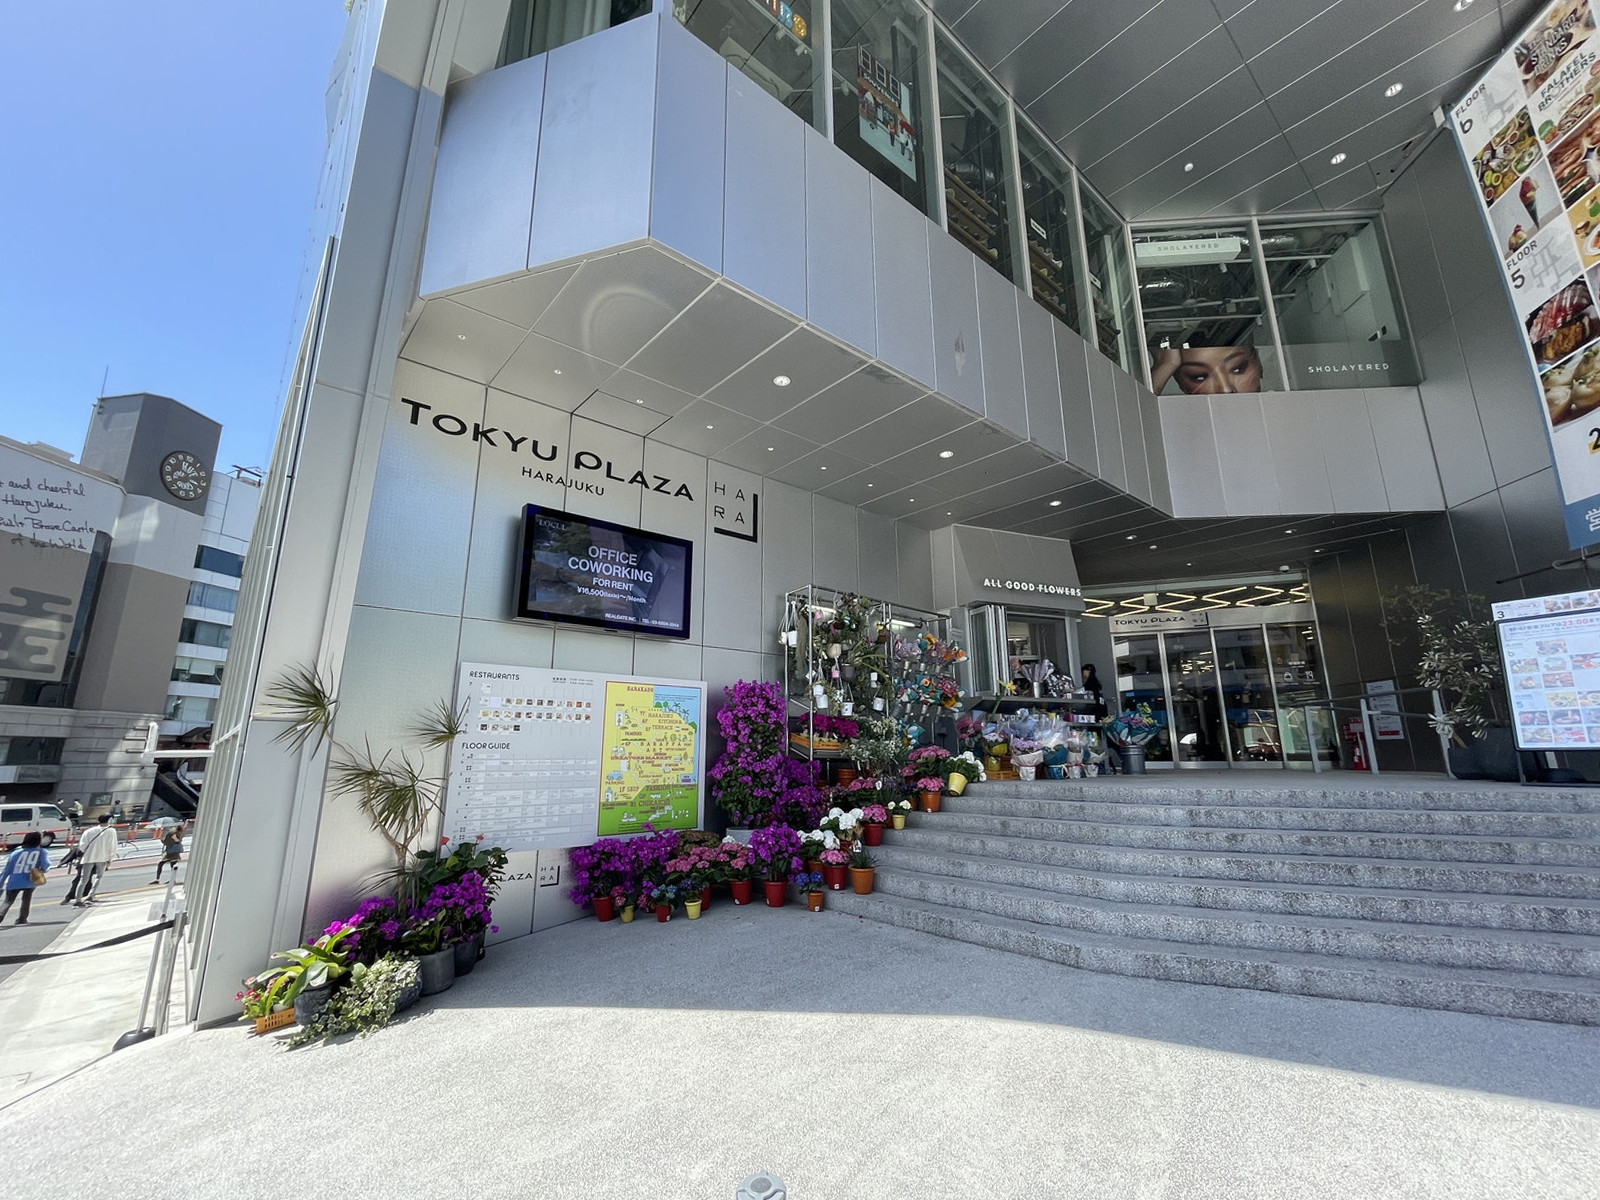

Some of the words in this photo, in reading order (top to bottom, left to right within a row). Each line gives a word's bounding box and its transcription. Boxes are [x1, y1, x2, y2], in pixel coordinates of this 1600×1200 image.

[1537, 51, 1597, 112] BROTHERS
[1540, 52, 1587, 98] FALAFEL
[1455, 83, 1486, 119] FLOOR
[1157, 242, 1220, 251] SHOLAYERED
[1506, 240, 1538, 270] FLOOR
[1511, 268, 1525, 290] 5
[1307, 362, 1390, 374] SHOLAYERED
[401, 397, 558, 462] TOKYU
[574, 450, 695, 502] PLAZA
[8, 477, 33, 491] and
[37, 477, 86, 497] cheerful
[521, 465, 606, 497] HARAJUKU
[588, 545, 638, 566] OFFICE
[568, 556, 653, 583] COWORKING
[592, 577, 611, 588] FOR
[611, 579, 634, 592] RENT
[983, 578, 1002, 588] ALL
[1005, 580, 1035, 591] GOOD
[1037, 584, 1081, 597] FLOWERS
[1150, 616, 1186, 624] PLAZA
[1496, 610, 1505, 619] 3
[469, 671, 520, 681] RESTAURANTS
[12, 850, 40, 874] 49
